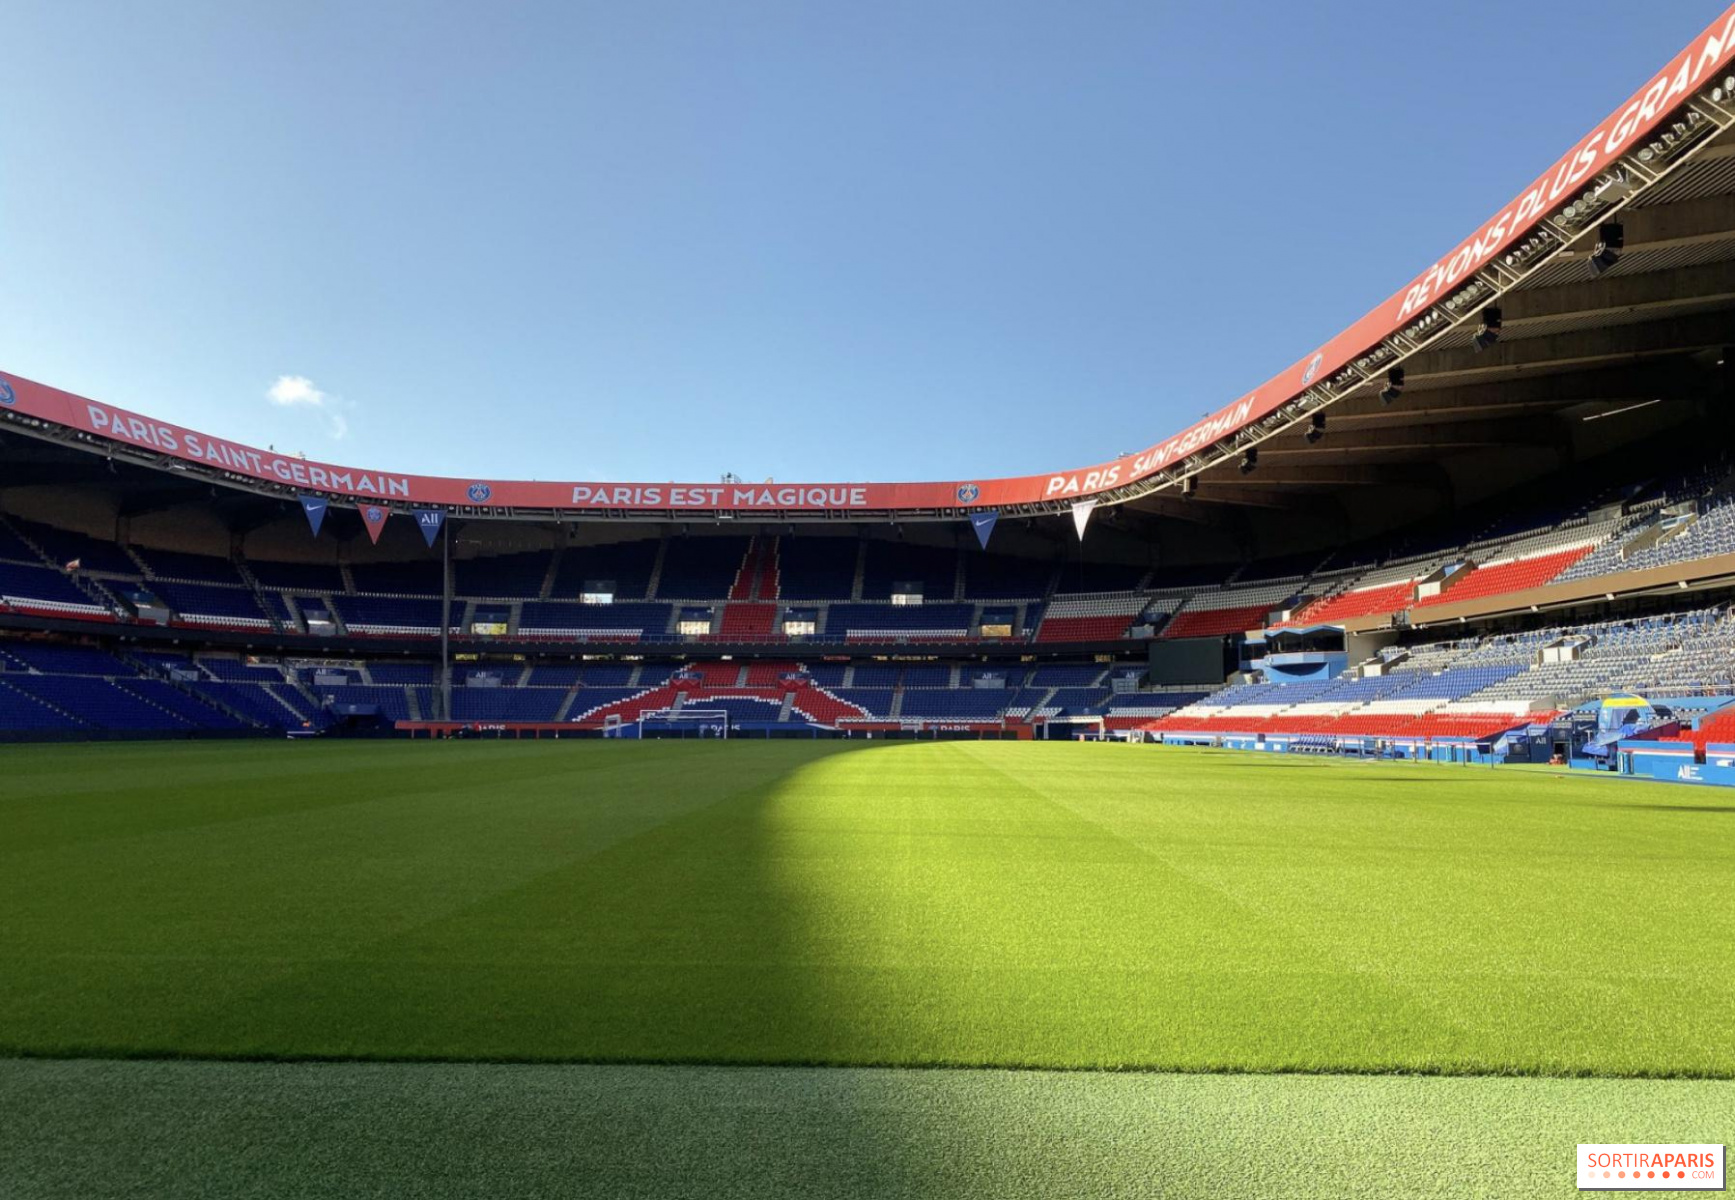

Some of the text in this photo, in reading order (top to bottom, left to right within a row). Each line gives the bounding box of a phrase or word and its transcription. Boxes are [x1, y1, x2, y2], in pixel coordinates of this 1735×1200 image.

[1397, 212, 1512, 321] RÊVONS
[1508, 130, 1606, 237] PLUS
[87, 404, 410, 497] PARIS SAINT-GERMAIN
[1047, 397, 1254, 496] PARIS SAINT-GERMAIN
[572, 486, 867, 507] PARIS EST MAGIQUE
